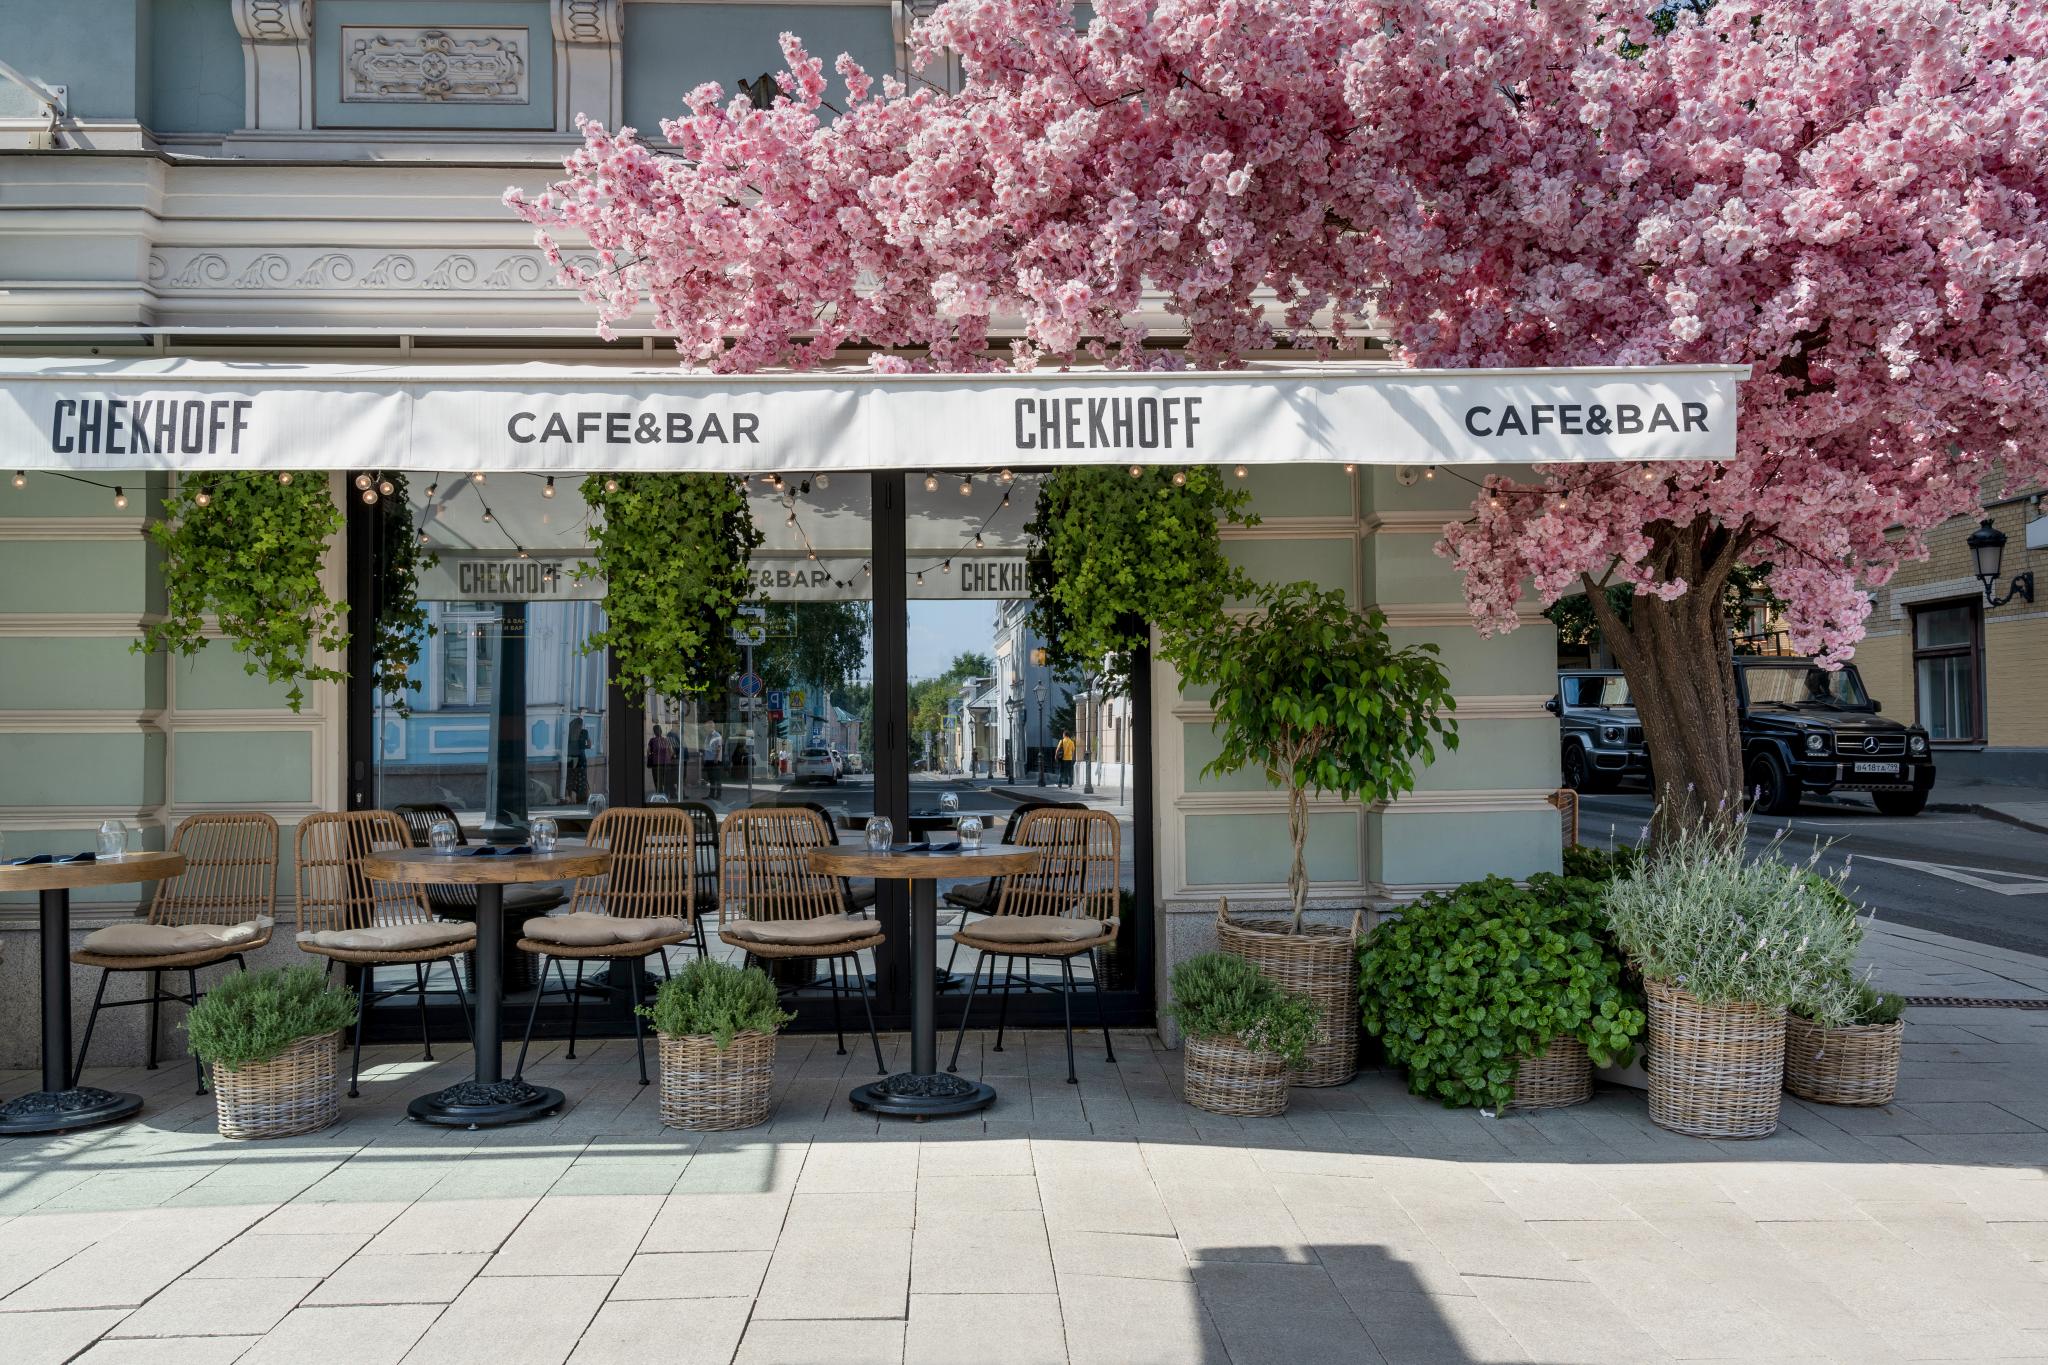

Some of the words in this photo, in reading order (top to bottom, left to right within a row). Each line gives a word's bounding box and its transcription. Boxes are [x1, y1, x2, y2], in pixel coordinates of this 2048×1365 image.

[53, 400, 252, 454] CHEKHOFF
[508, 412, 758, 443] CAFE&BAR
[1016, 398, 1201, 449] CHEKHOFF
[1465, 402, 1709, 436] CAFE&BAR
[459, 563, 564, 593] CHEKHOFF
[748, 570, 828, 588] E&BAR
[958, 563, 1031, 591] CHEKH
